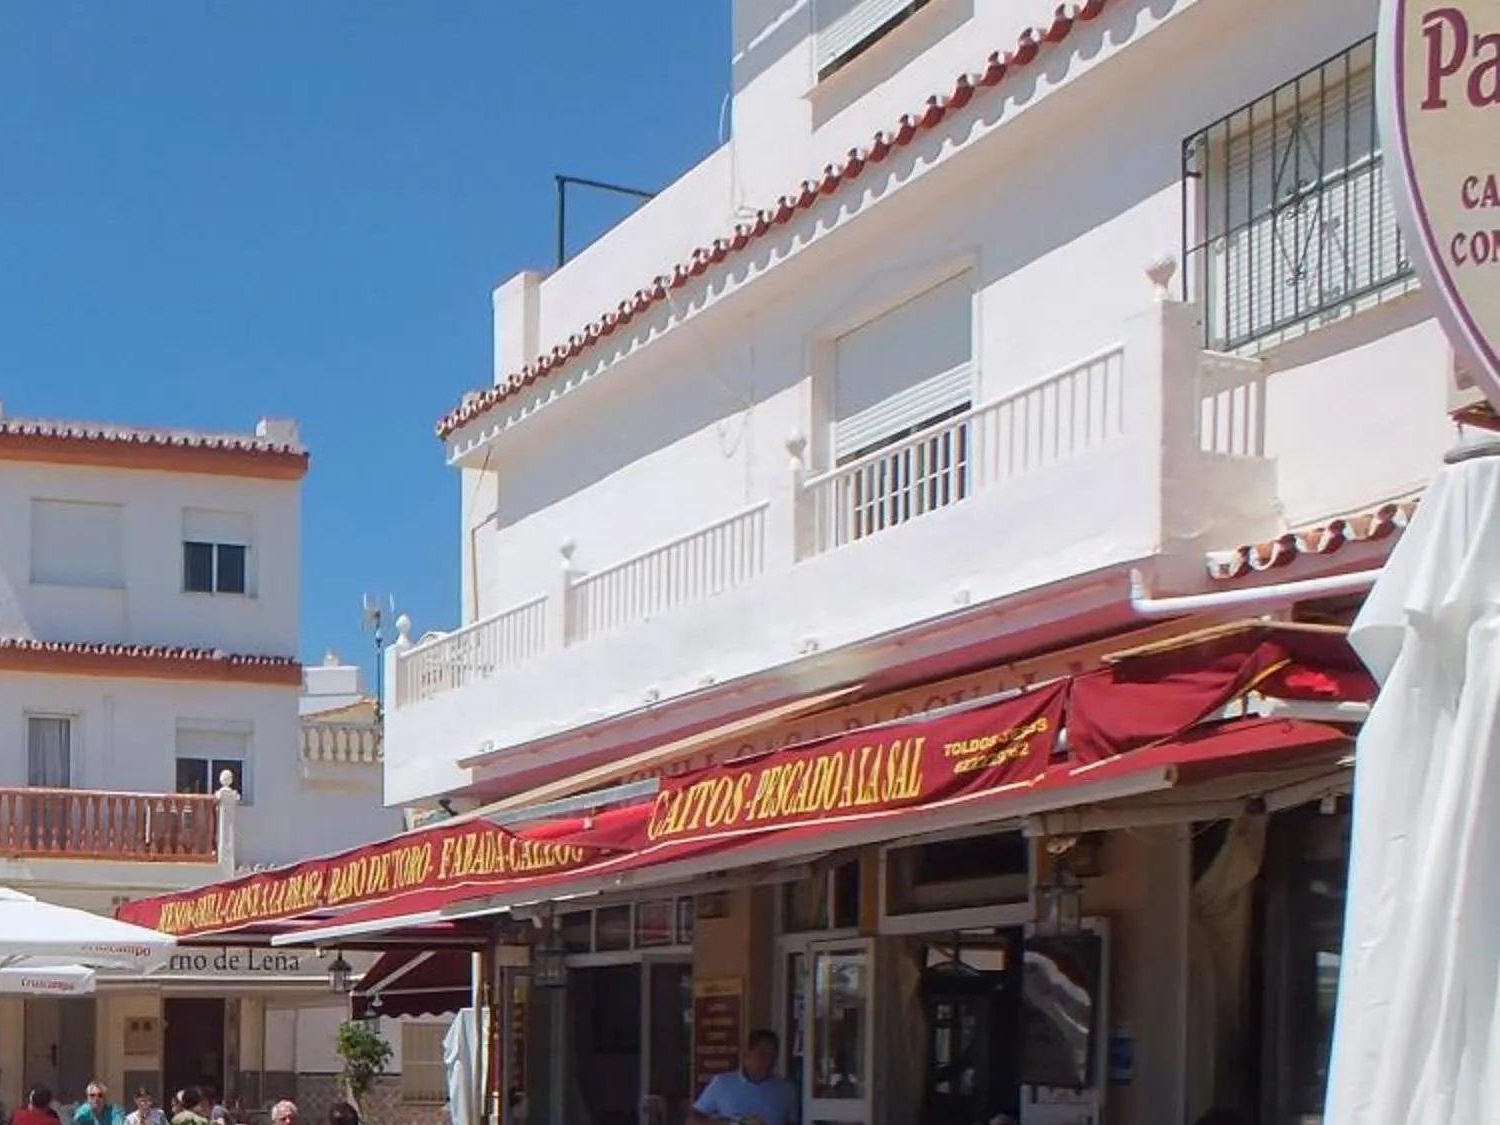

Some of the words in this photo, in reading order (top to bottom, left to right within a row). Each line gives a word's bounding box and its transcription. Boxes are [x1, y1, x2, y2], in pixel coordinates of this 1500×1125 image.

[1421, 8, 1500, 110] Pa
[884, 736, 927, 801] SAL
[213, 945, 240, 971] de
[248, 949, 300, 971] Leña
